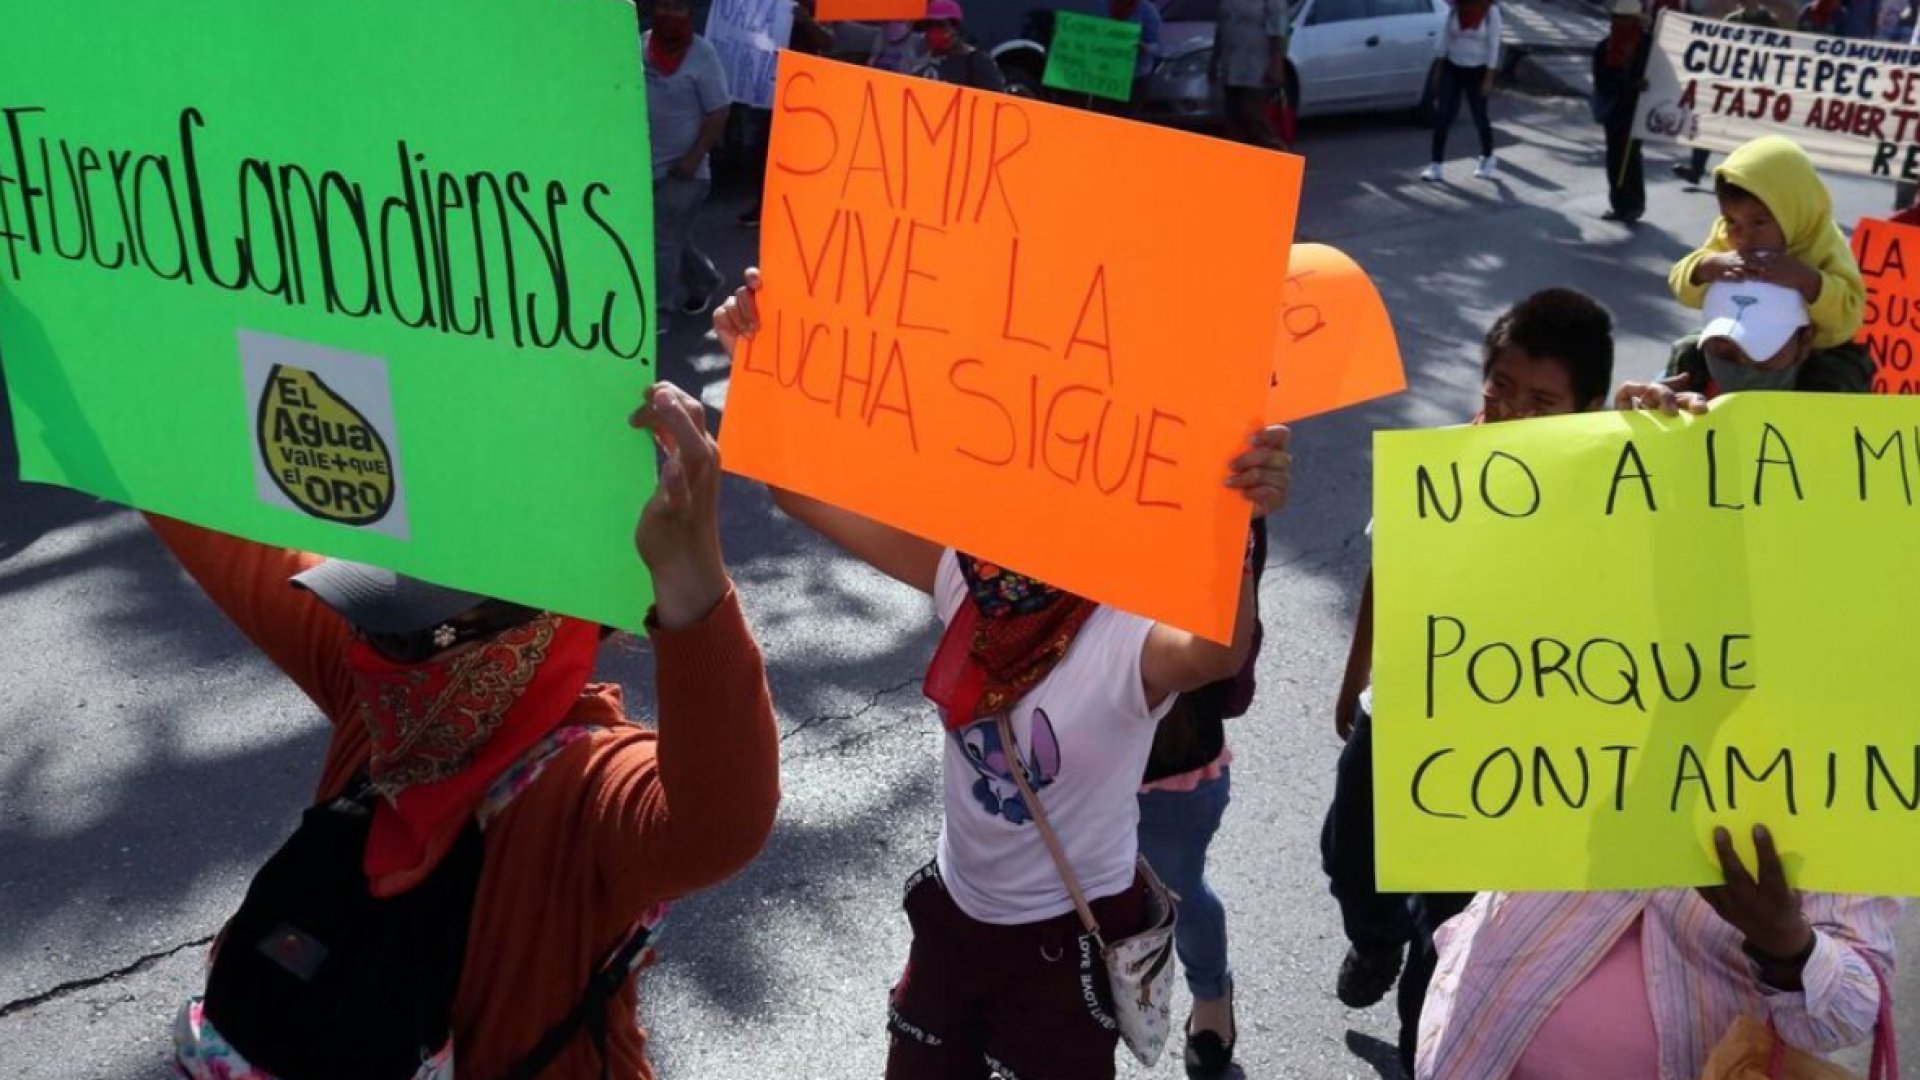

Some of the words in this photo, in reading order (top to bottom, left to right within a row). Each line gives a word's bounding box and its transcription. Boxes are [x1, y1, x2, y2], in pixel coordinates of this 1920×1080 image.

[1691, 21, 1793, 49] NUESTRA
[1678, 79, 1698, 110] A
[1711, 84, 1793, 123] TAJO
[775, 71, 1032, 234] SAMIR
[1858, 228, 1906, 279] LA
[782, 194, 950, 335] VIVE
[1001, 236, 1115, 386] LA
[1867, 332, 1913, 372] NO
[742, 308, 919, 454] LUCHA
[947, 357, 1188, 511] SIGUE
[304, 475, 384, 514] ORO
[1416, 450, 1541, 523] NO
[1605, 440, 1658, 516] A
[1706, 421, 1804, 510] LA
[1853, 422, 1920, 508] M
[1426, 614, 1757, 719] PORQUE
[1410, 743, 1920, 820] CONTAMIN
[1078, 935, 1092, 969] LOVE
